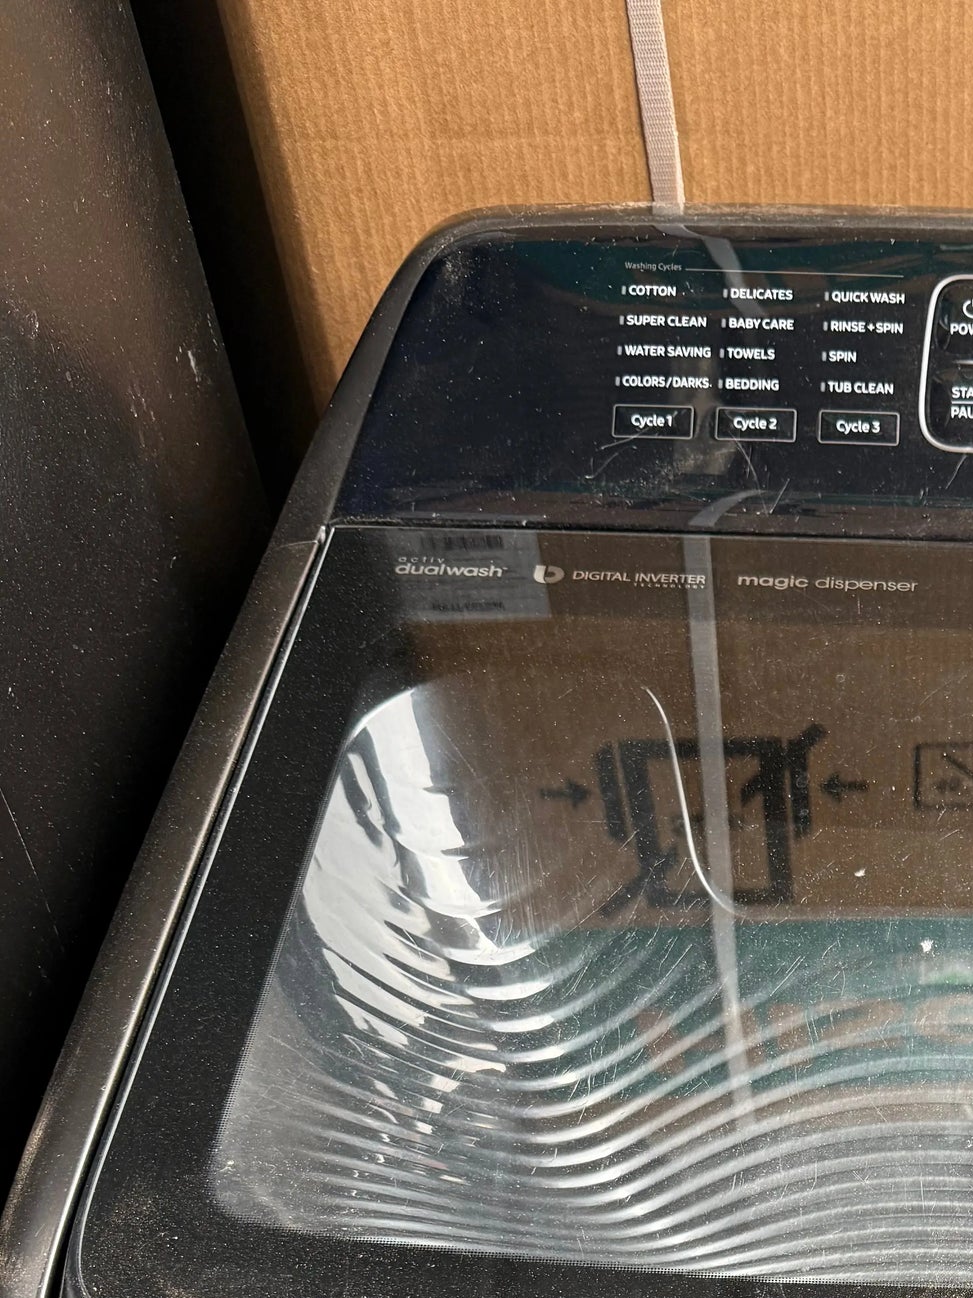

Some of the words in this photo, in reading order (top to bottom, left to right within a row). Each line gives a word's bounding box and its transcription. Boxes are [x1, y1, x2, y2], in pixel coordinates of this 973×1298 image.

[624, 262, 656, 271] Washing
[658, 262, 682, 272] Cycles
[628, 284, 677, 296] COTTON
[731, 288, 794, 300] DELICATES
[832, 291, 869, 304] QUICK
[870, 292, 906, 304] WASH
[626, 315, 666, 328] SUPER
[667, 316, 707, 328] CLEAN
[728, 318, 762, 330] BABY
[762, 318, 794, 331] CARE
[830, 321, 866, 334] RINSE
[624, 346, 665, 358] WATER
[666, 346, 712, 359] SAVING
[727, 348, 776, 360] TOWELS
[828, 351, 857, 363] SPIN
[622, 376, 710, 389] COLORS/DARKS
[725, 378, 780, 391] BEDDING
[828, 381, 852, 394] TUB
[852, 382, 894, 395] CLEAN
[630, 414, 664, 428] Cycle
[666, 416, 674, 428] 1
[733, 418, 766, 432] Cycle
[768, 418, 778, 430] 2
[836, 421, 870, 435] Cycle
[871, 422, 880, 434] 3
[398, 556, 446, 564] activ
[572, 570, 631, 582] DIGITAL
[634, 572, 706, 585] INVERTER
[737, 574, 809, 590] magic
[815, 576, 918, 592] dispenser
[634, 582, 706, 590] TECHNOLOGY
